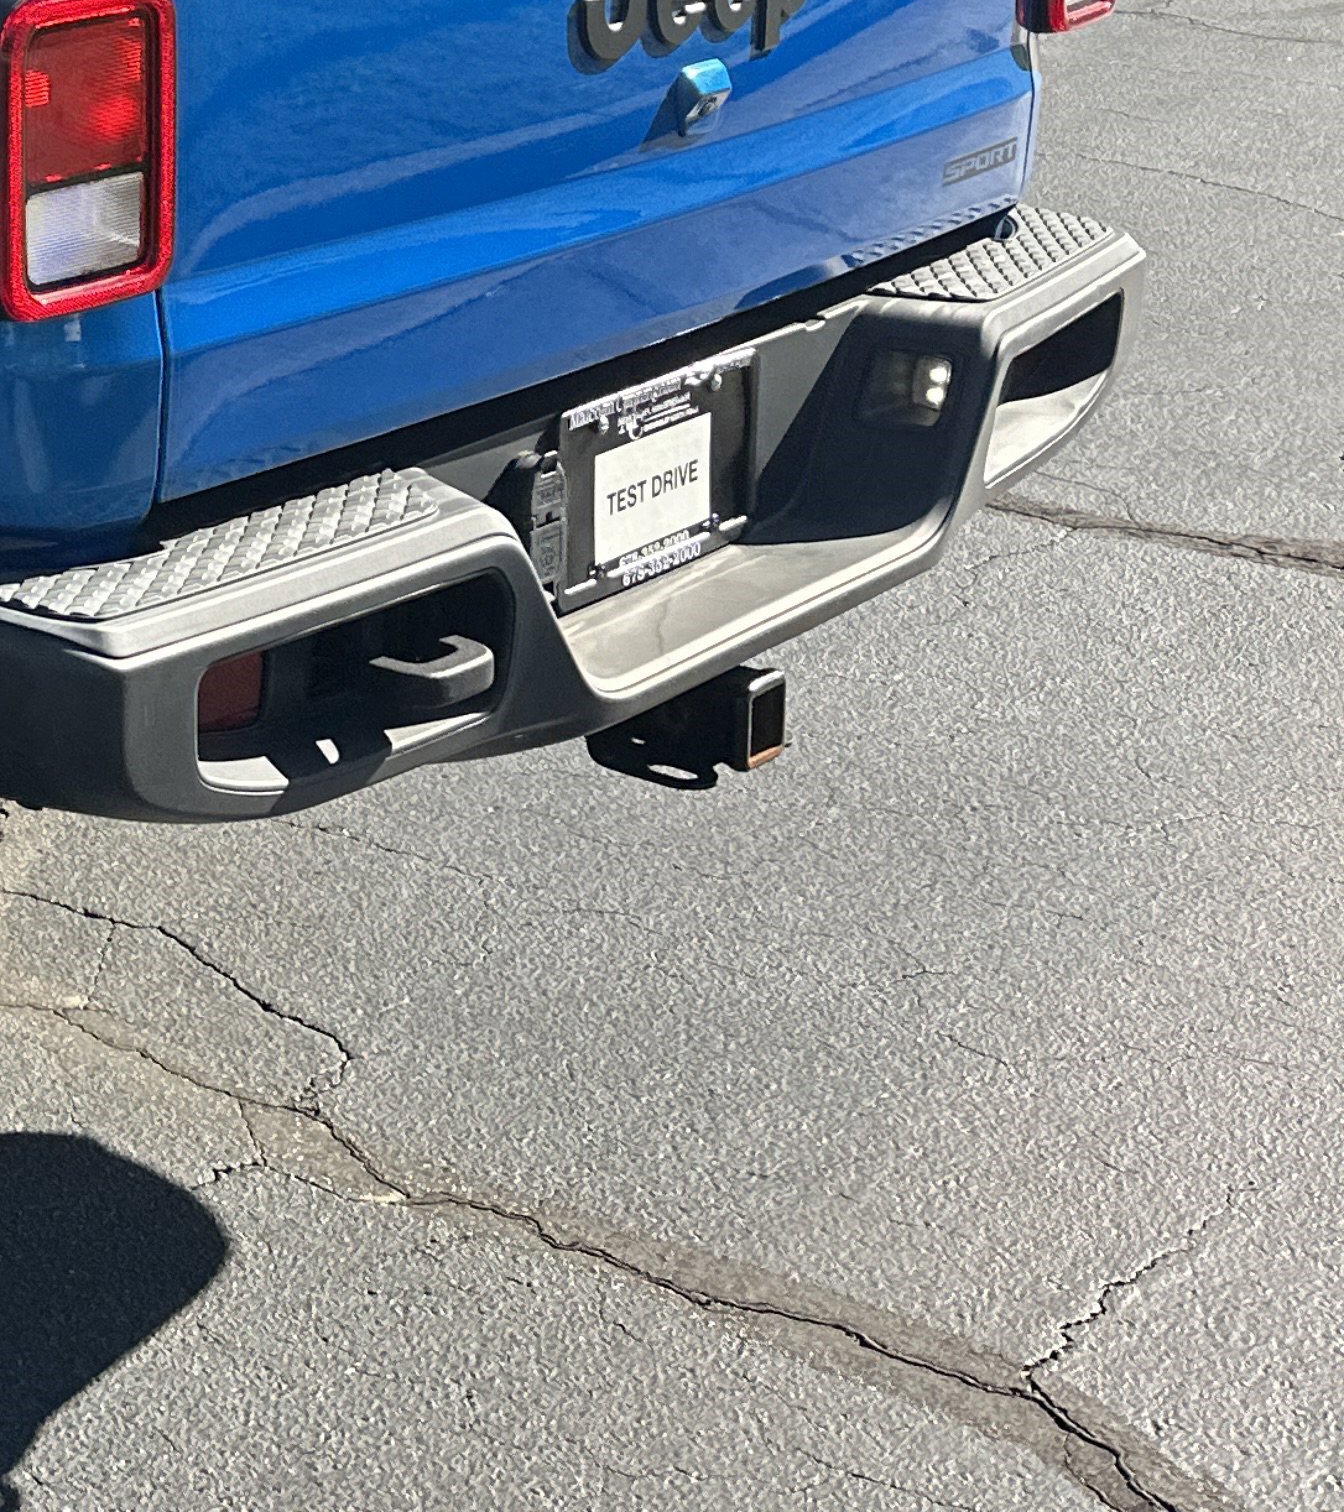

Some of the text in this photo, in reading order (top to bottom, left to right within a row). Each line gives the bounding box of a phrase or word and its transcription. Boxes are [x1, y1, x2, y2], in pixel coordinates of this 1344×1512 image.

[943, 140, 1017, 185] SPORT
[606, 458, 699, 516] TEST DRIVE
